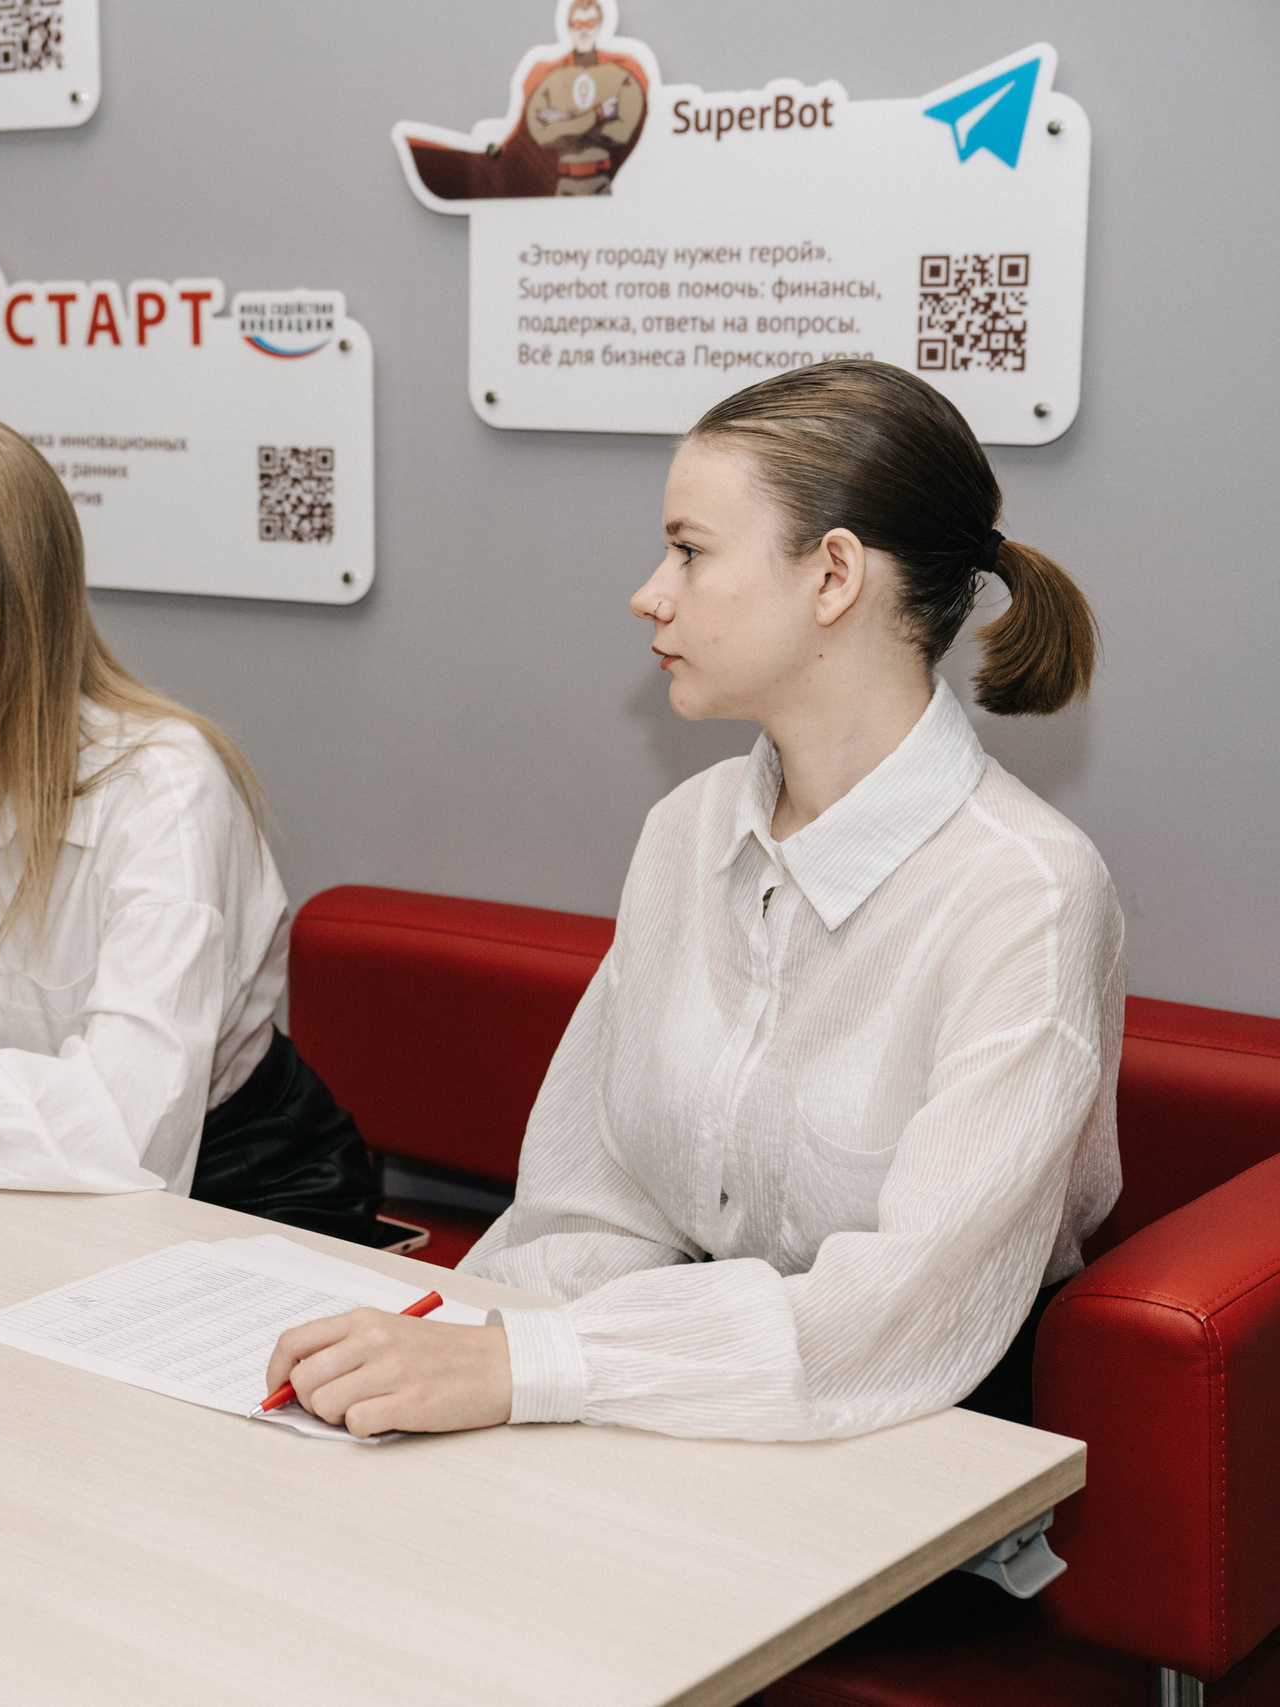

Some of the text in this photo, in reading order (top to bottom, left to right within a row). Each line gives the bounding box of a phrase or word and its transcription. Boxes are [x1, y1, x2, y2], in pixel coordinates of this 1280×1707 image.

[673, 95, 834, 141] SuperBot
[520, 241, 832, 270] «Этому городу нужен герой».
[519, 276, 882, 303] Superbot готов помочь: финансы,
[5, 291, 212, 347] СТАРТ
[519, 315, 860, 339] поддержка, ответы на вопросы.
[520, 345, 553, 366] Всё
[557, 350, 595, 368] для
[602, 344, 686, 367] бизнеса
[694, 346, 814, 373] Пермского
